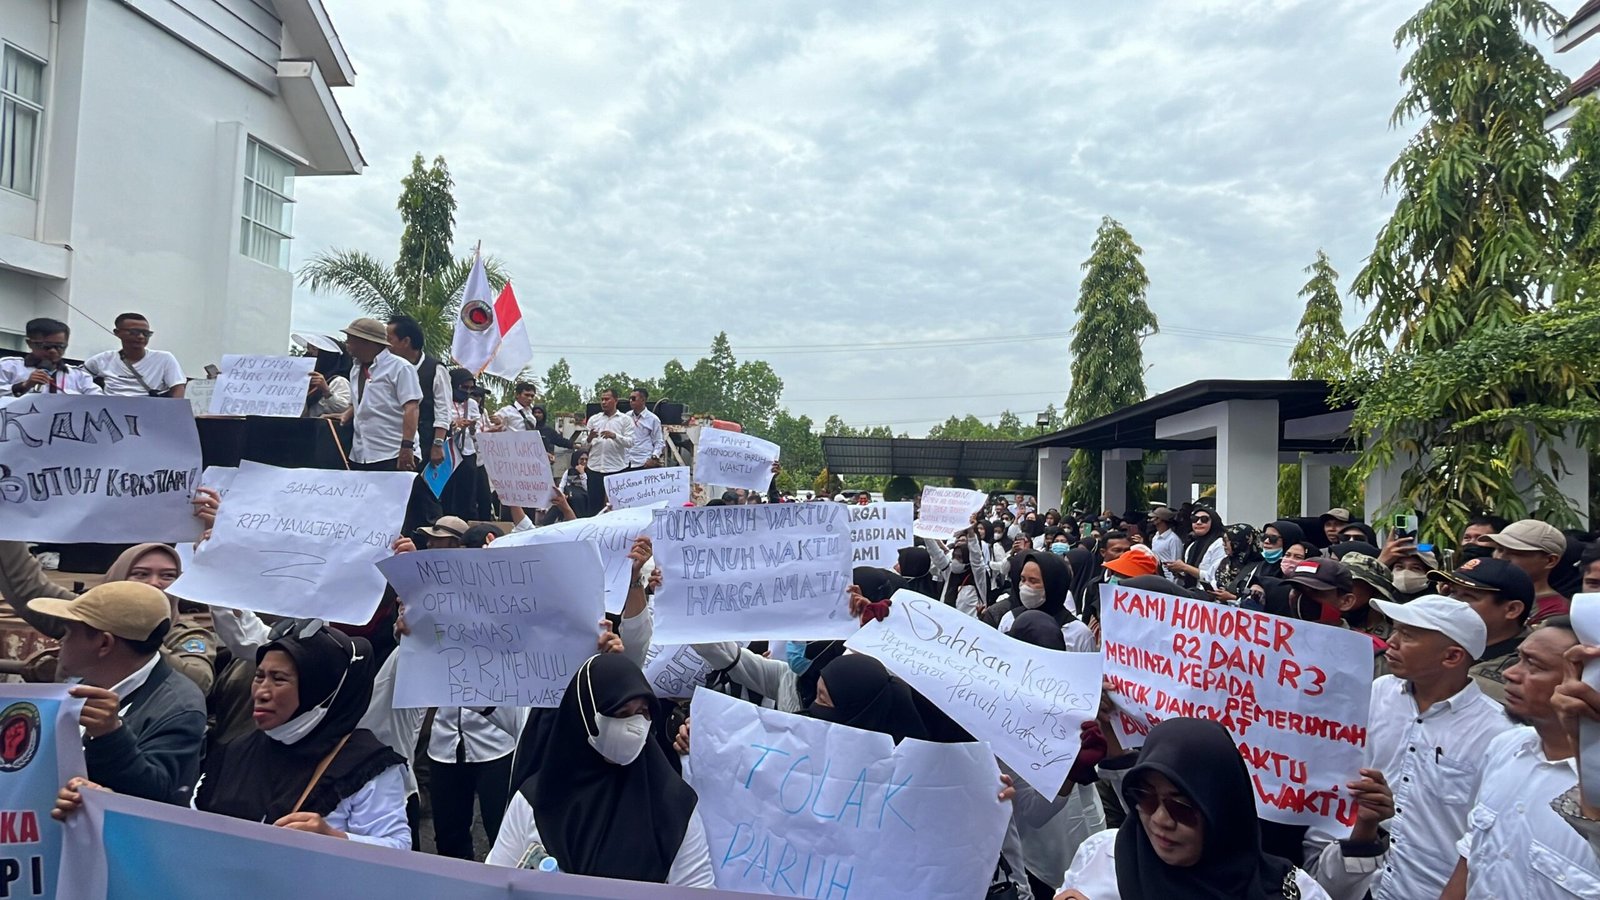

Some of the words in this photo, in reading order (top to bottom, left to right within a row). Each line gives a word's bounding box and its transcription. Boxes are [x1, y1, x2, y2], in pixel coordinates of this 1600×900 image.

[0, 403, 141, 448] KAMI
[720, 435, 746, 447] TAHAP
[0, 464, 101, 504] BUTUH
[719, 462, 753, 474] WAKTU
[636, 487, 656, 498] Sudah
[236, 513, 271, 530] RPP
[273, 517, 361, 540] MANAJEMEN
[362, 530, 394, 549] ASN
[654, 508, 705, 542] TOLAK
[705, 507, 757, 539] PARUH
[763, 504, 840, 533] WAKTU!
[848, 506, 887, 522] RGAI
[850, 527, 906, 542] GABDIAN
[681, 544, 756, 580] PENUH
[852, 545, 880, 561] AMI
[415, 559, 542, 587] MENUNTUT
[422, 592, 537, 614] OPTIMALISASI
[686, 581, 768, 617] HARGA
[433, 621, 522, 647] FORMASI
[901, 599, 1012, 678] Sahkan
[1113, 588, 1167, 622] KAMI
[1170, 597, 1295, 657] HONORER
[499, 650, 568, 686] MENUJU
[1104, 639, 1174, 679] MEMINTA
[1177, 662, 1257, 704] KEPADA
[1172, 633, 1202, 661] R2
[1207, 640, 1266, 680] DAN
[1277, 658, 1327, 697] R3
[449, 683, 519, 706] PENUH
[1224, 697, 1367, 748] PEMERINTAH
[1238, 741, 1308, 785] AKTU
[743, 743, 916, 833] TOLAK
[1251, 773, 1360, 828] WAKTU
[0, 811, 41, 845] KA
